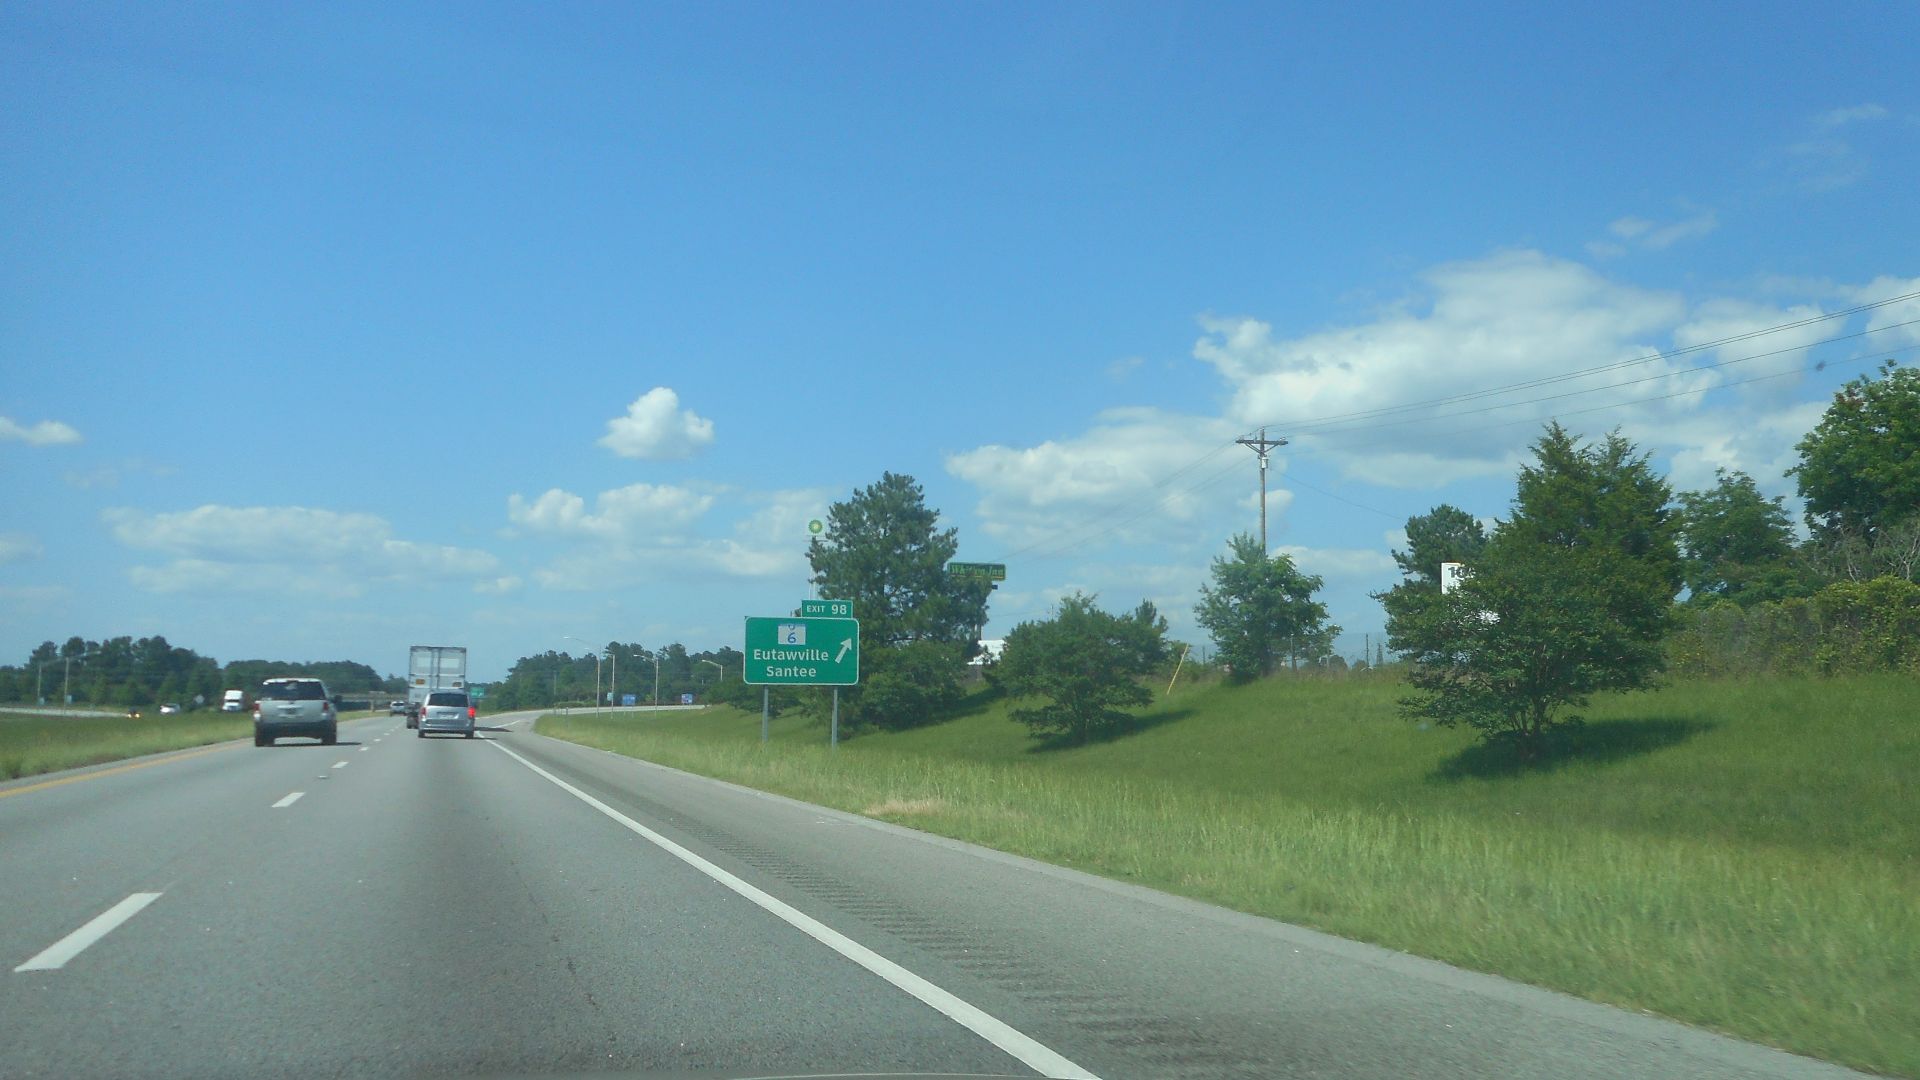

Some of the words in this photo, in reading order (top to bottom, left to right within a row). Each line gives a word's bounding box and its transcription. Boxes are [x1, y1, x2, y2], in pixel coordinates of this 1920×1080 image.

[806, 605, 826, 613] EXIT
[831, 604, 847, 615] 98
[787, 632, 797, 644] 6
[753, 649, 829, 661] Eutawville
[766, 666, 817, 677] Santee
